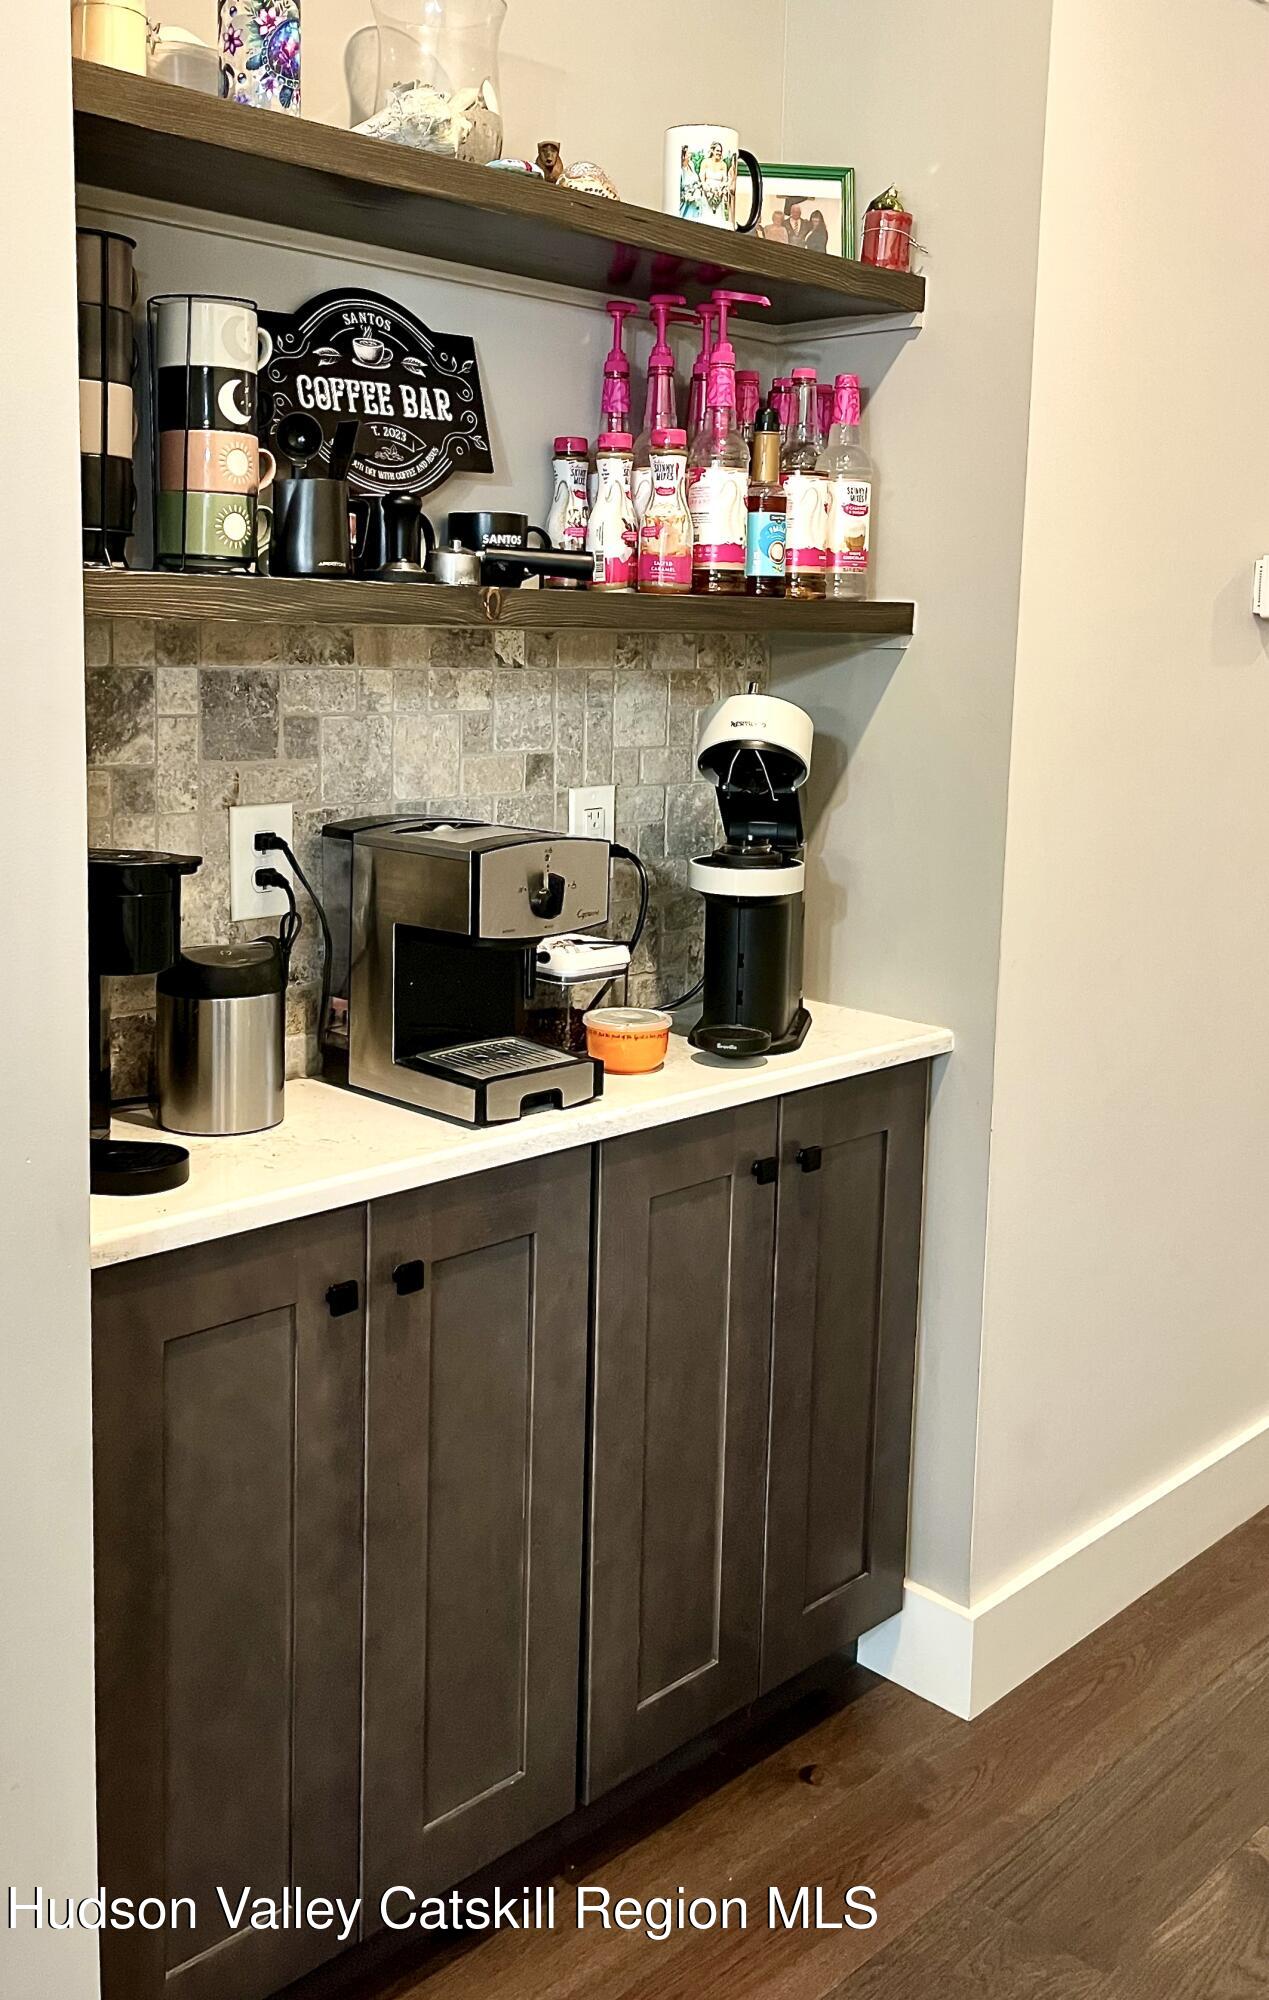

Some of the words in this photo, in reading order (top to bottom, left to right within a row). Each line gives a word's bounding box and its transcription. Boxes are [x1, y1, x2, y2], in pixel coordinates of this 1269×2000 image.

[342, 312, 391, 332] SANTOS
[296, 374, 395, 417] COFFEE
[398, 384, 453, 421] BAR
[382, 426, 407, 442] 2023
[395, 466, 418, 480] COFFEE
[482, 533, 522, 545] SANTOS
